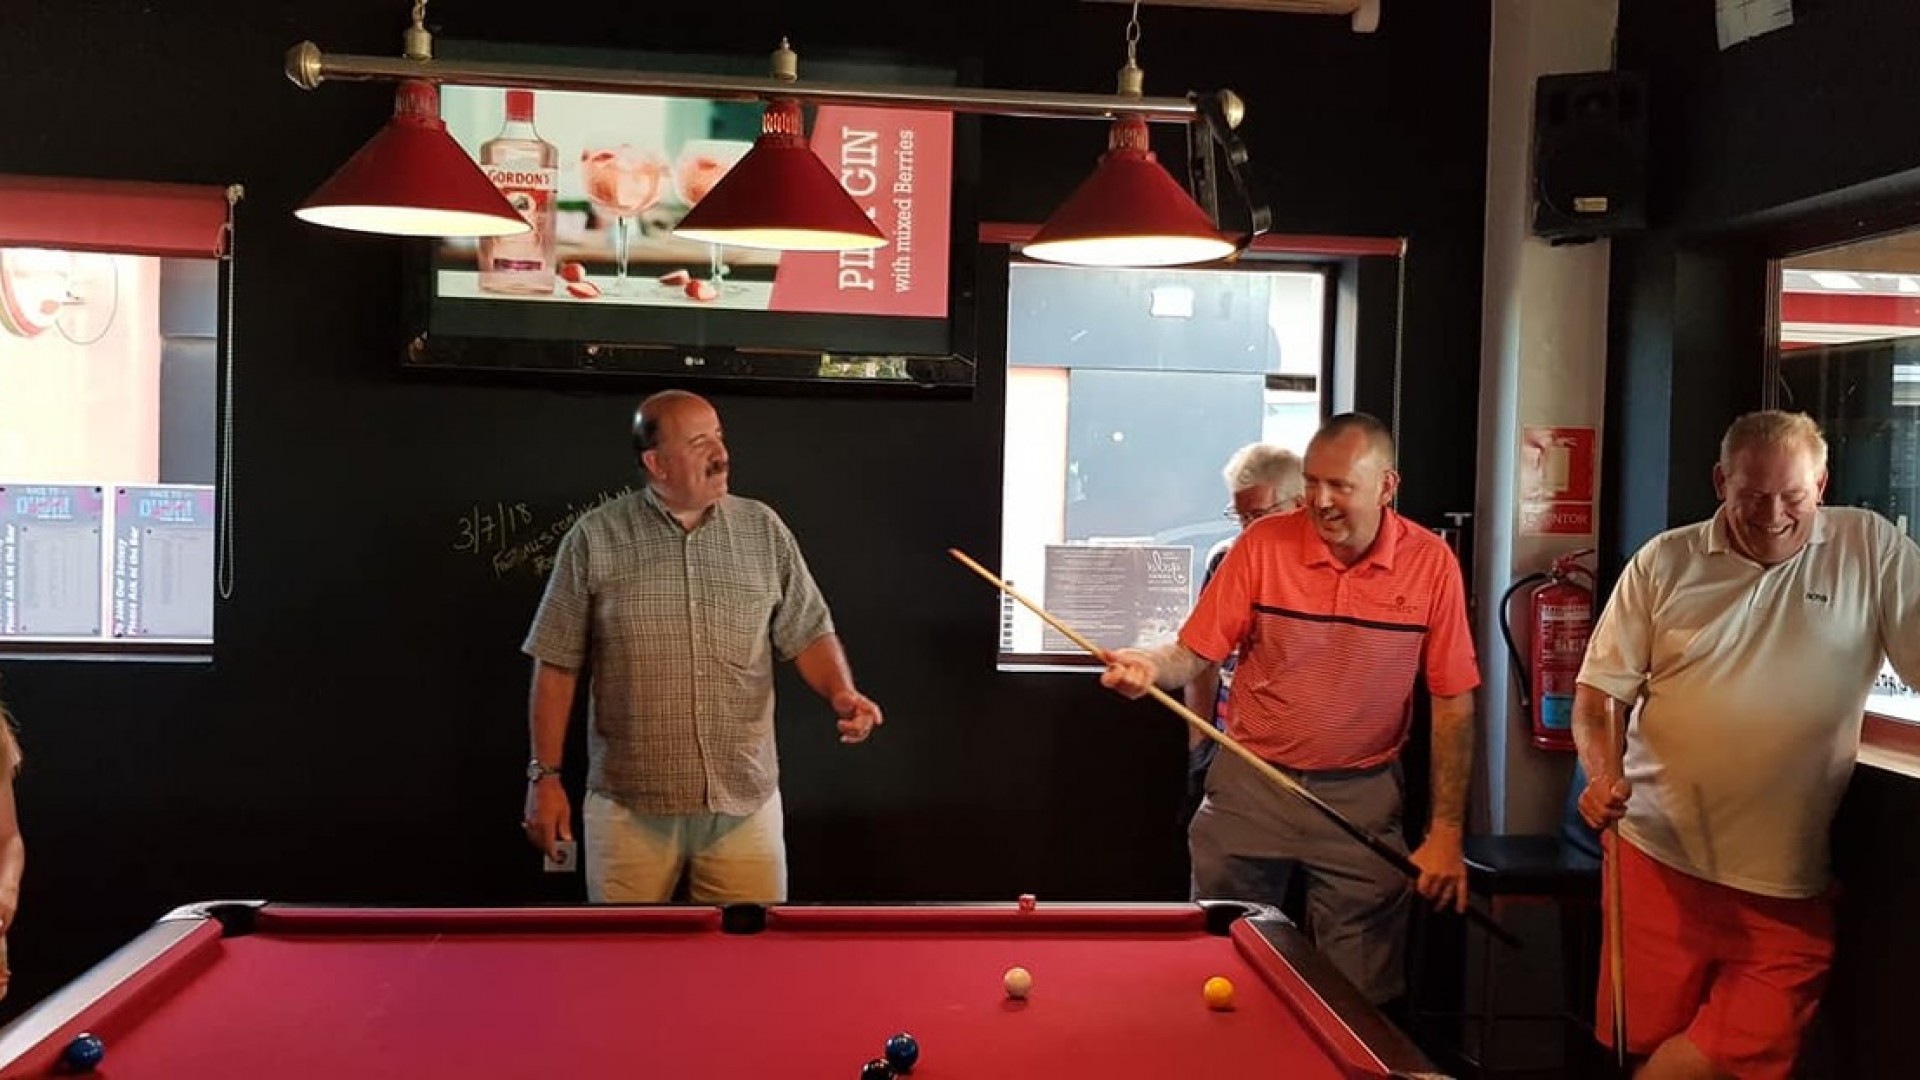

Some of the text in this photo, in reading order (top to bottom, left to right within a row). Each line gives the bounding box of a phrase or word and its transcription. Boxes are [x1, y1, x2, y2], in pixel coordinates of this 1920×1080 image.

[838, 126, 878, 291] PI GIN
[891, 129, 914, 292] with mixed Berries
[453, 501, 532, 554] 3/7/18
